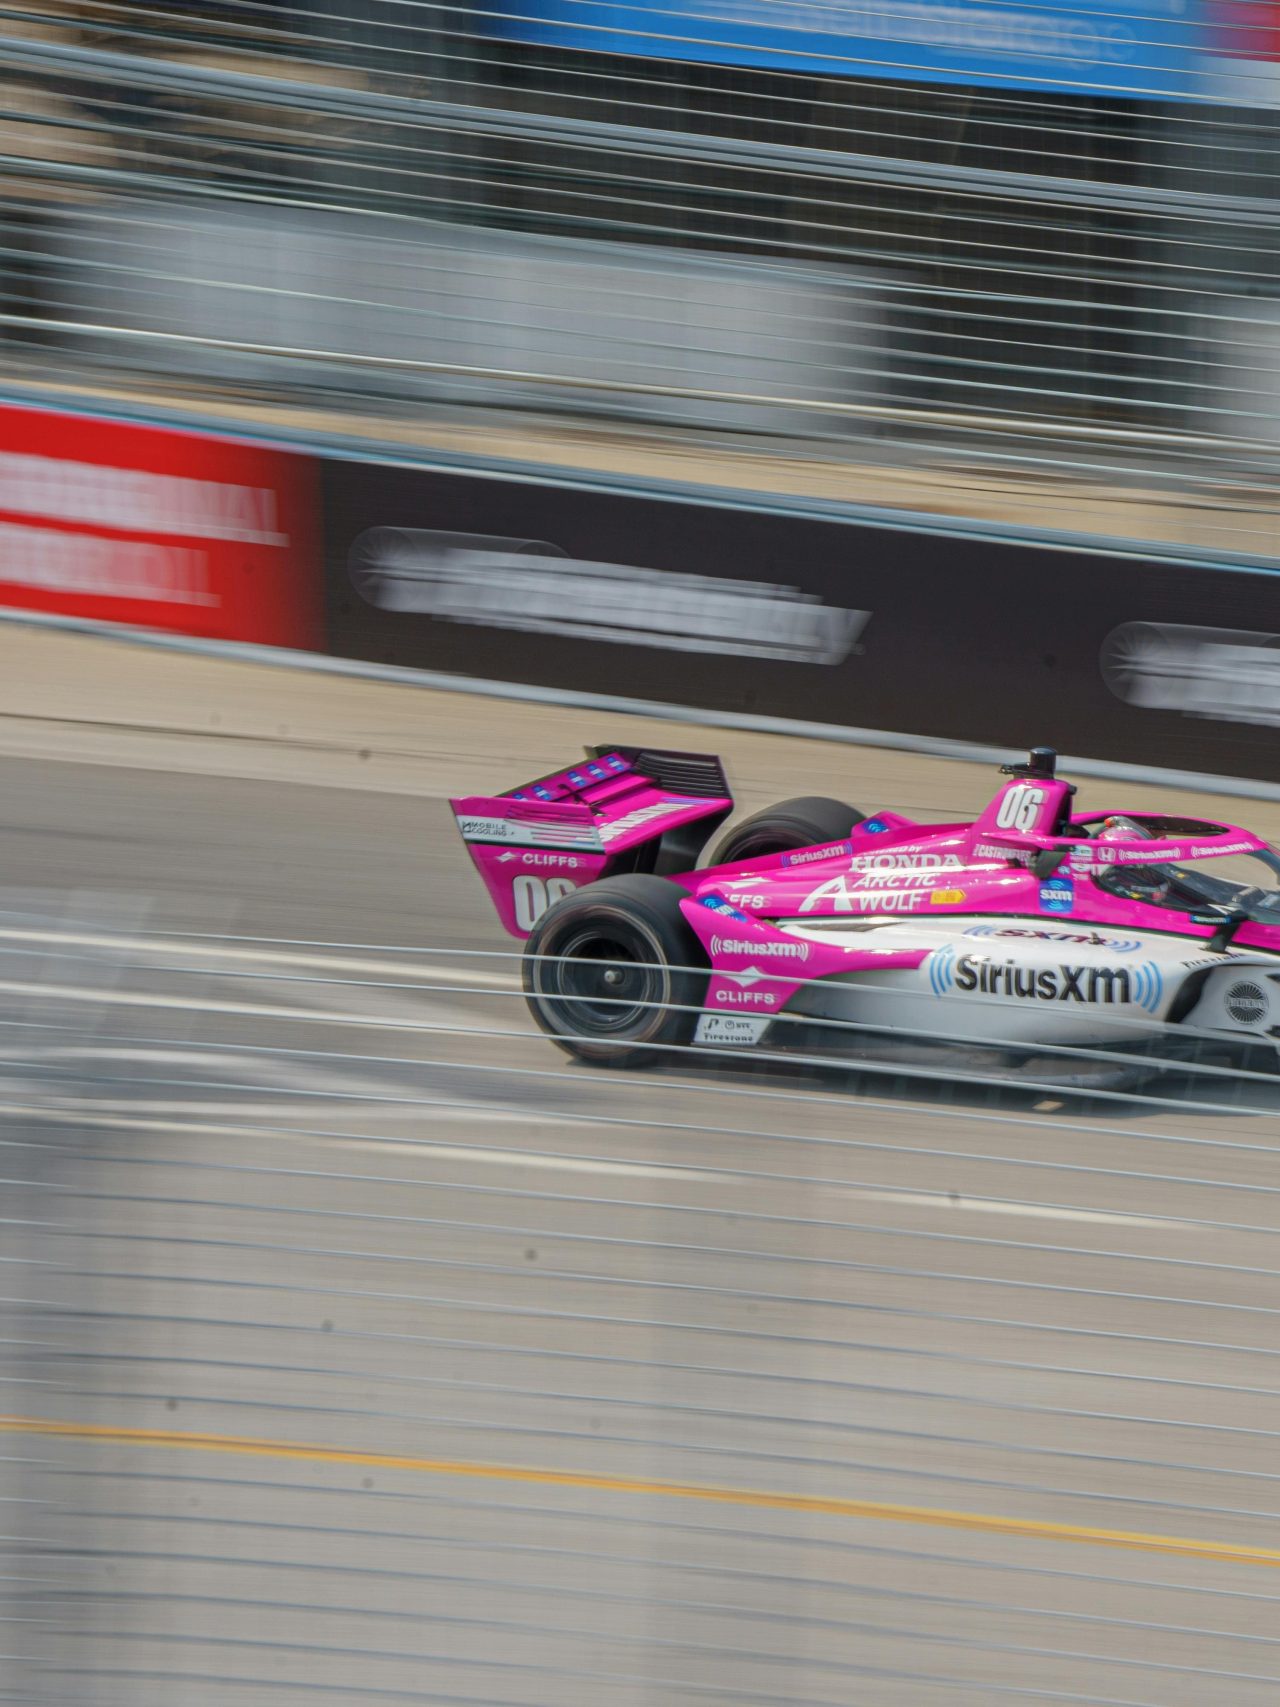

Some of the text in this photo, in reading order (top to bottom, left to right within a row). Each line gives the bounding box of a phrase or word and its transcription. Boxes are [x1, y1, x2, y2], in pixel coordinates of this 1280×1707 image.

[996, 785, 1044, 831] 06
[522, 852, 579, 868] CLIFFS
[848, 853, 964, 872] HONDA
[852, 873, 938, 888] ARCTIC
[859, 890, 922, 911] WOLF
[1040, 889, 1073, 901] sxm
[716, 990, 776, 1005] CLIFFS
